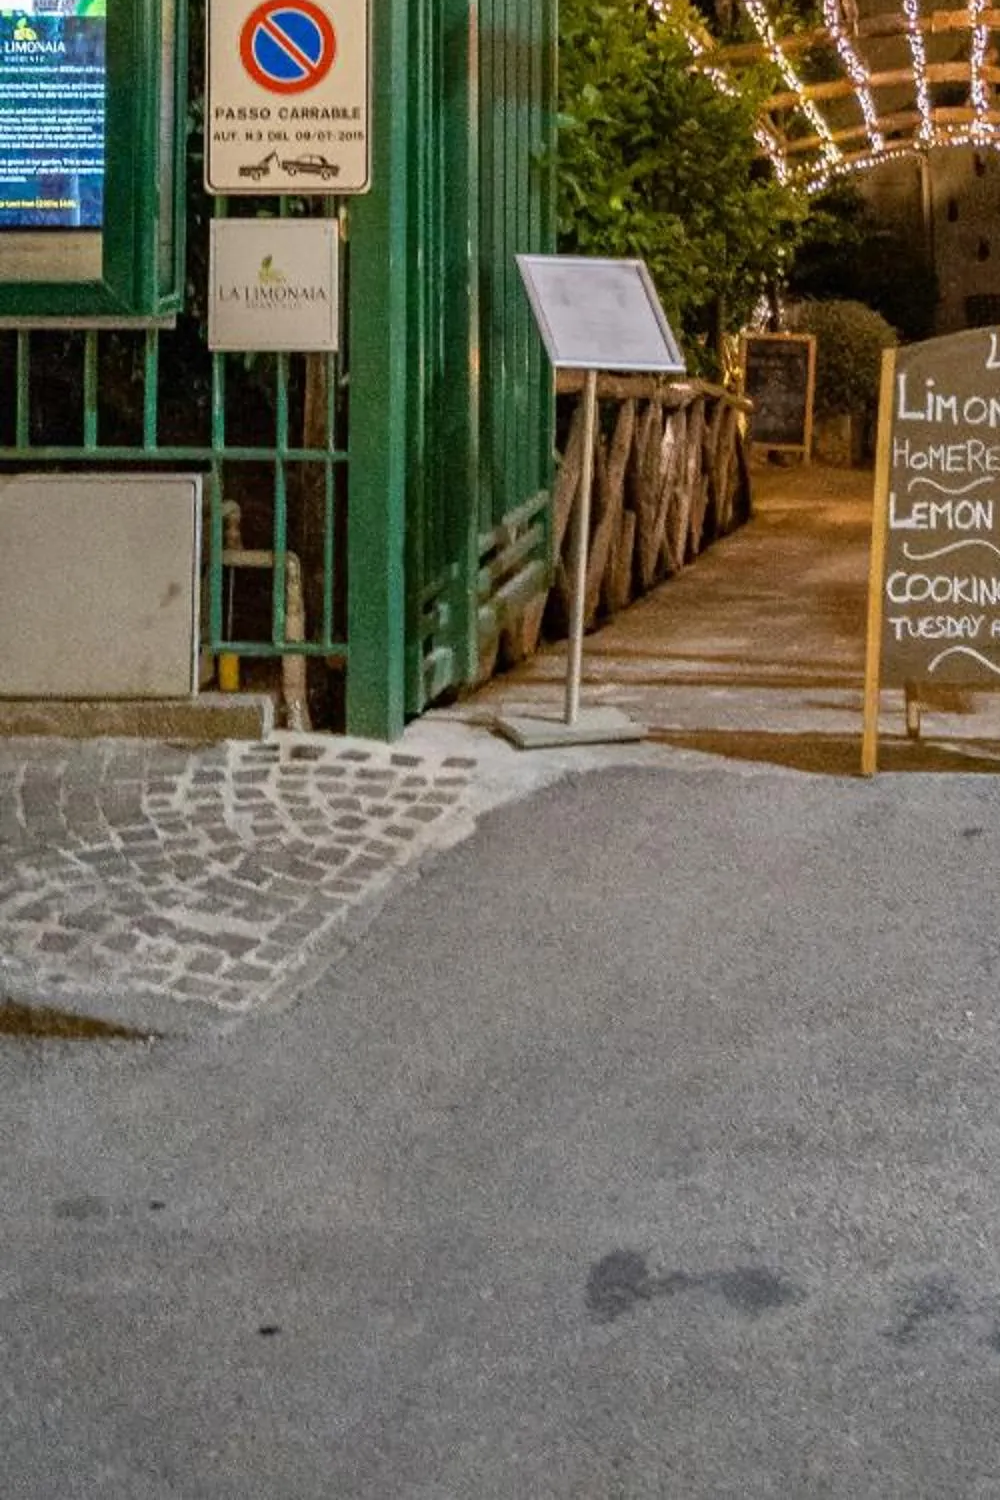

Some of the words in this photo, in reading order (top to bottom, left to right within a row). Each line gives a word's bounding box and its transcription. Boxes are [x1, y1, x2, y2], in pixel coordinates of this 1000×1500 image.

[4, 41, 66, 53] LIMONAIA
[215, 106, 271, 120] PASSO
[278, 106, 361, 120] CARRABILE
[267, 131, 289, 141] DEL
[219, 285, 241, 301] LA
[245, 285, 328, 302] LIMONAIA
[889, 492, 993, 530] LEMON
[888, 615, 985, 641] TUESDAY
